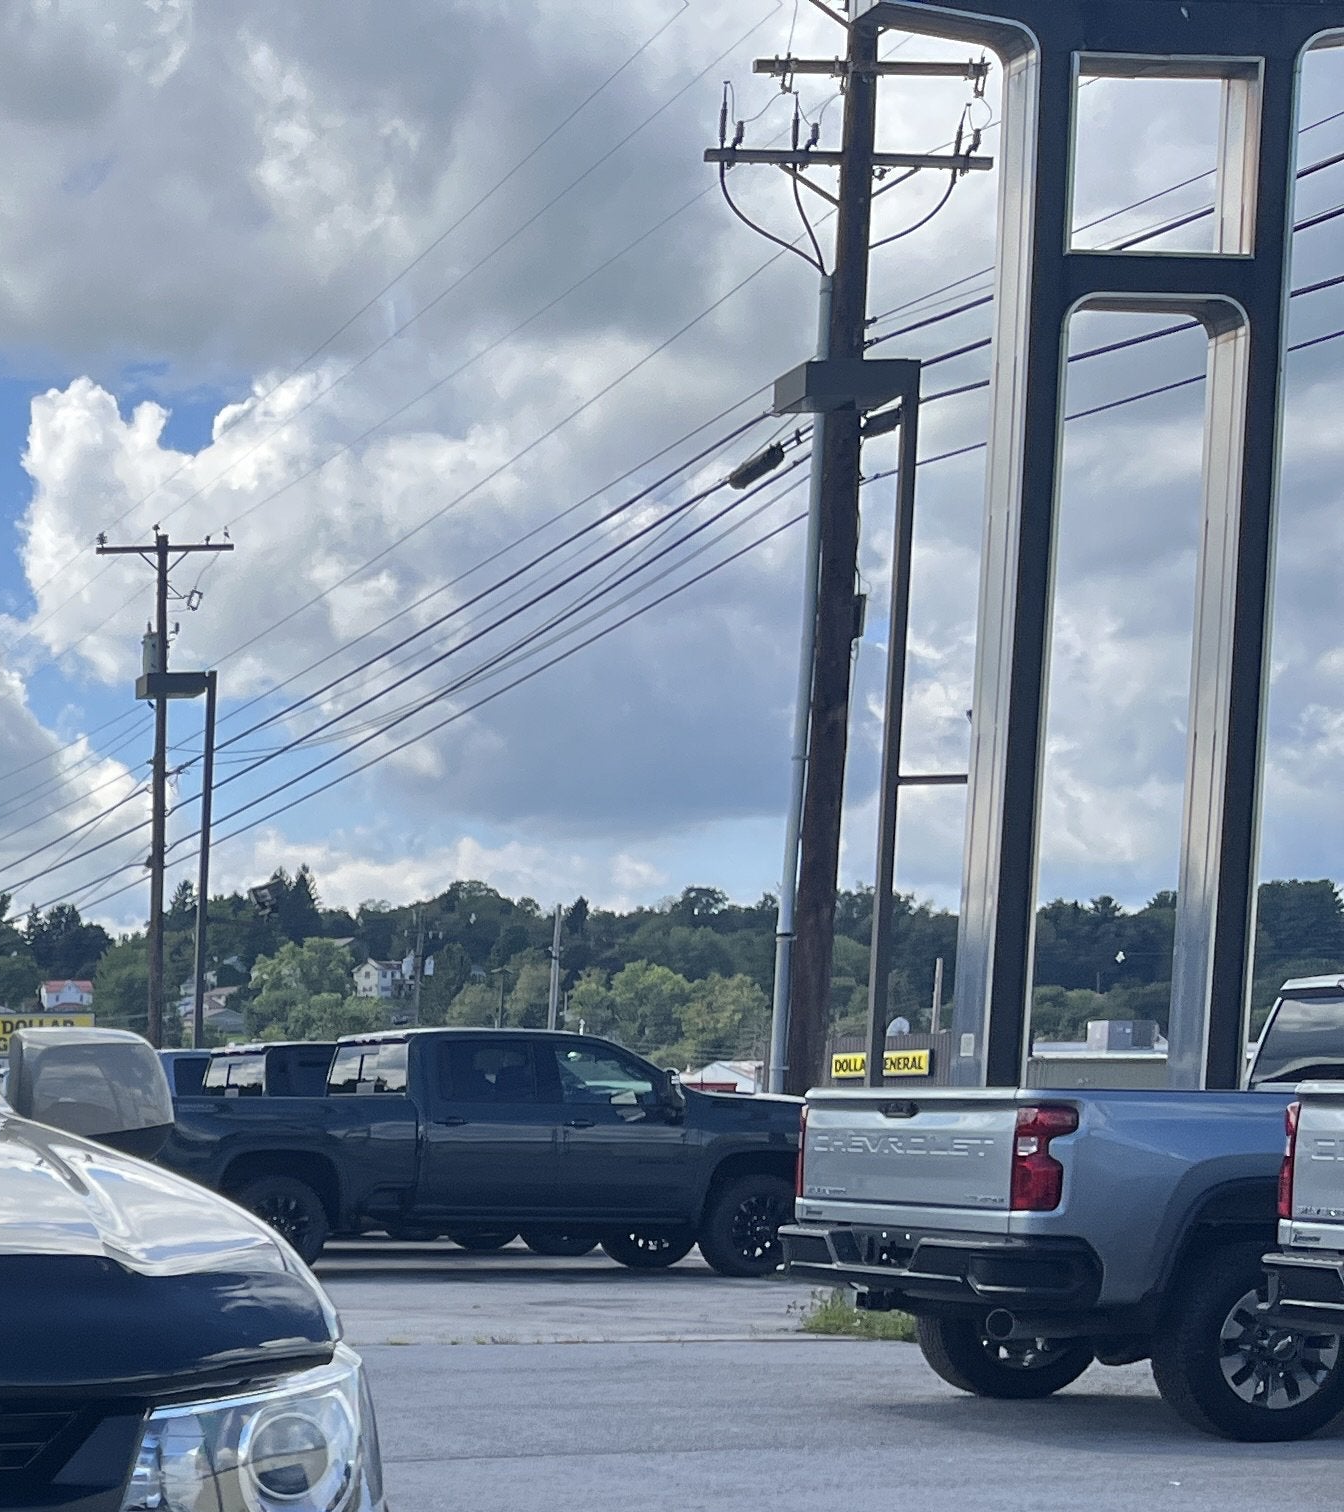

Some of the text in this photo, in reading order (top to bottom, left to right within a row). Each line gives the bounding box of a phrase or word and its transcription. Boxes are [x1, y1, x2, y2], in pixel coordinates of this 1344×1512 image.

[834, 1056, 924, 1073] DOLLA ENERAL
[813, 1133, 994, 1158] CHEVROLET
